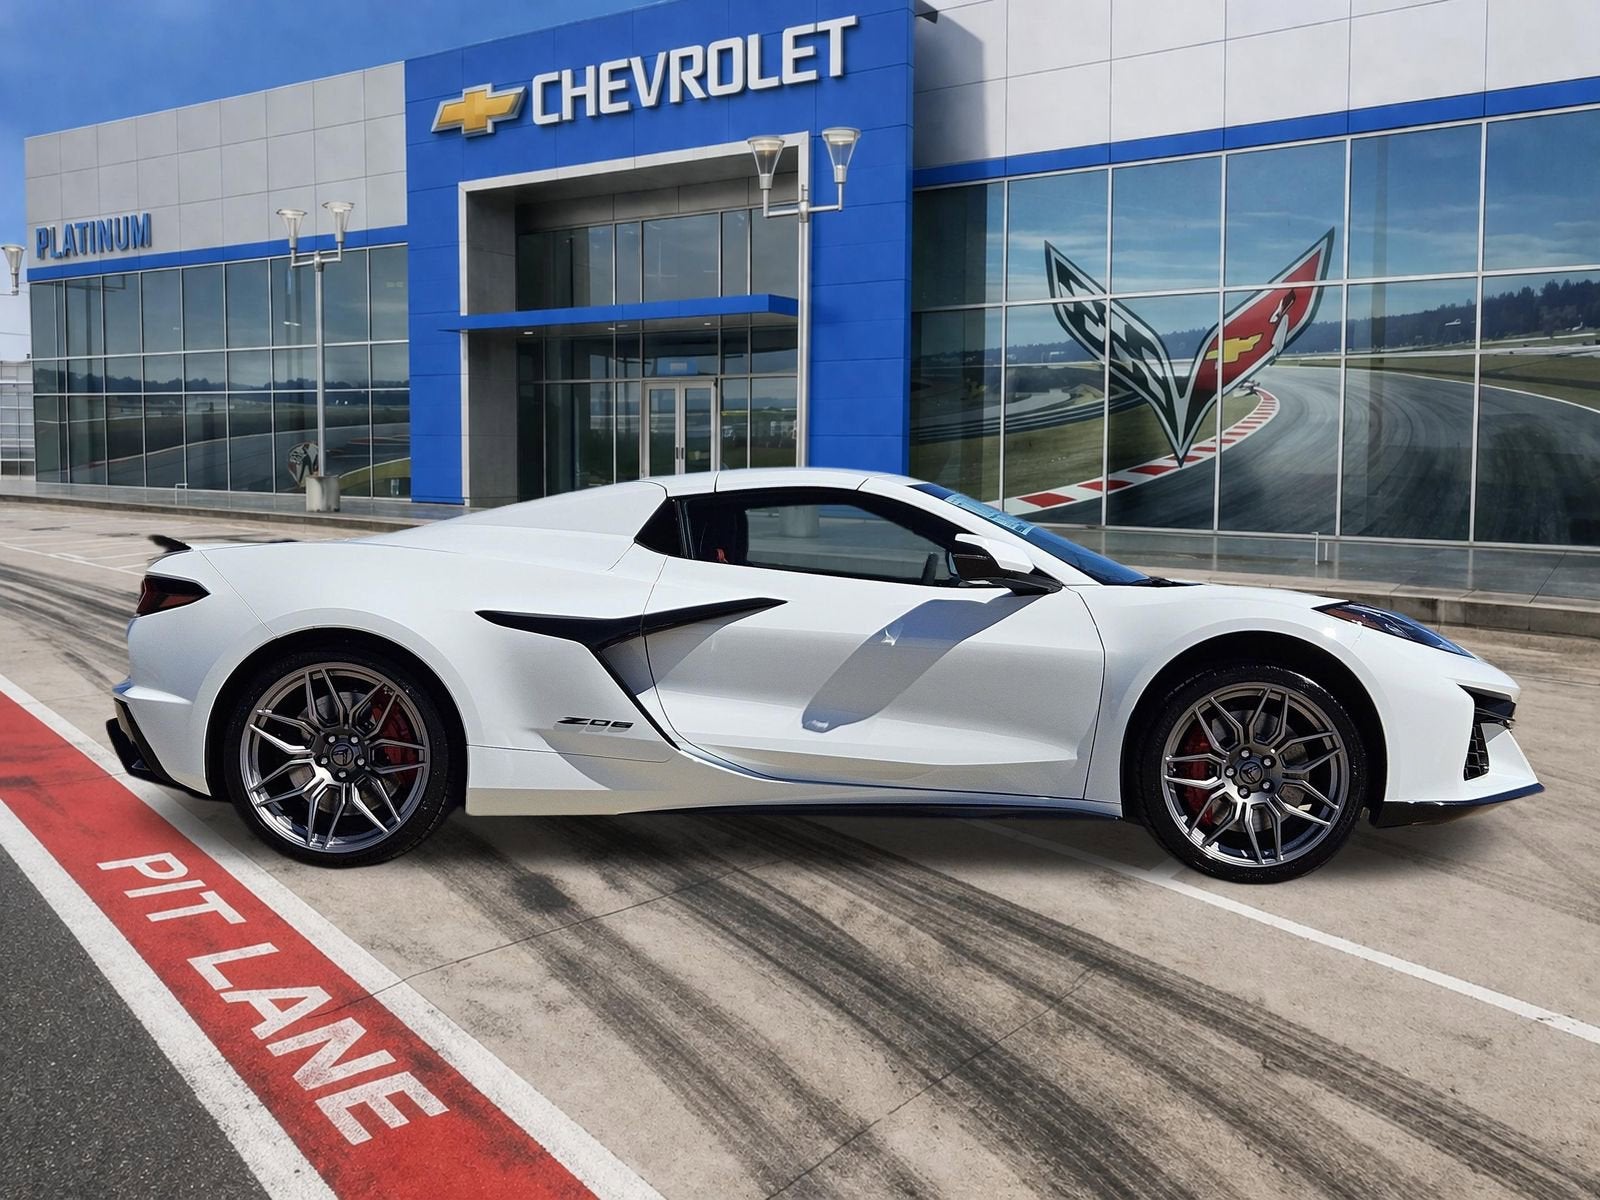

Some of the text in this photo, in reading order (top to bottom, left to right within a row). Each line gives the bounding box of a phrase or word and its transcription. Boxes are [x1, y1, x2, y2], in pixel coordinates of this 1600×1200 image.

[531, 15, 859, 125] CHEVROLET
[36, 213, 152, 259] PLATINUM
[556, 716, 635, 730] Z06
[96, 852, 450, 1146] PIT LANE
